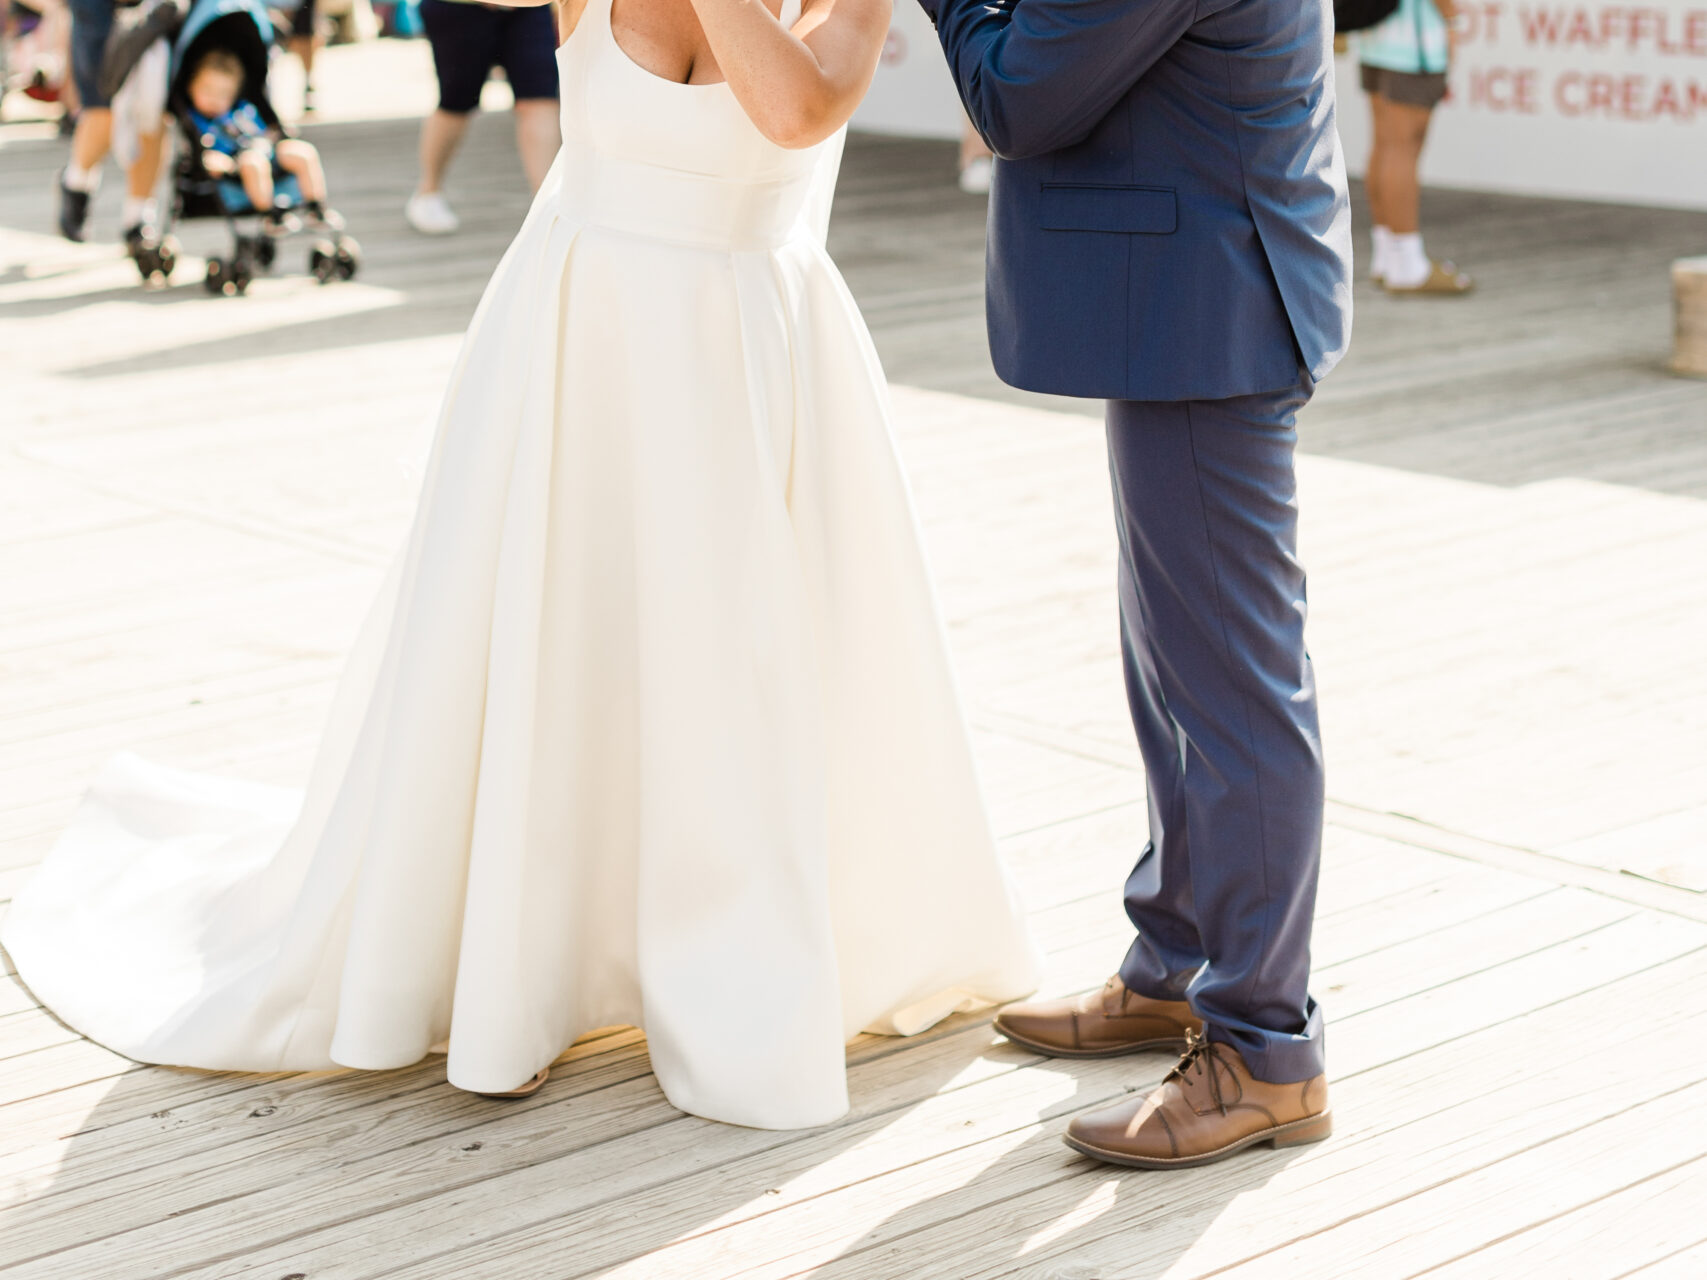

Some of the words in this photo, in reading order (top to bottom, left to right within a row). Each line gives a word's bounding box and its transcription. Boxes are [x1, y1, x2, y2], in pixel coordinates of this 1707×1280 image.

[1450, 0, 1503, 48] OT
[1516, 0, 1707, 58] WAFFLE
[1468, 66, 1541, 116] ICE
